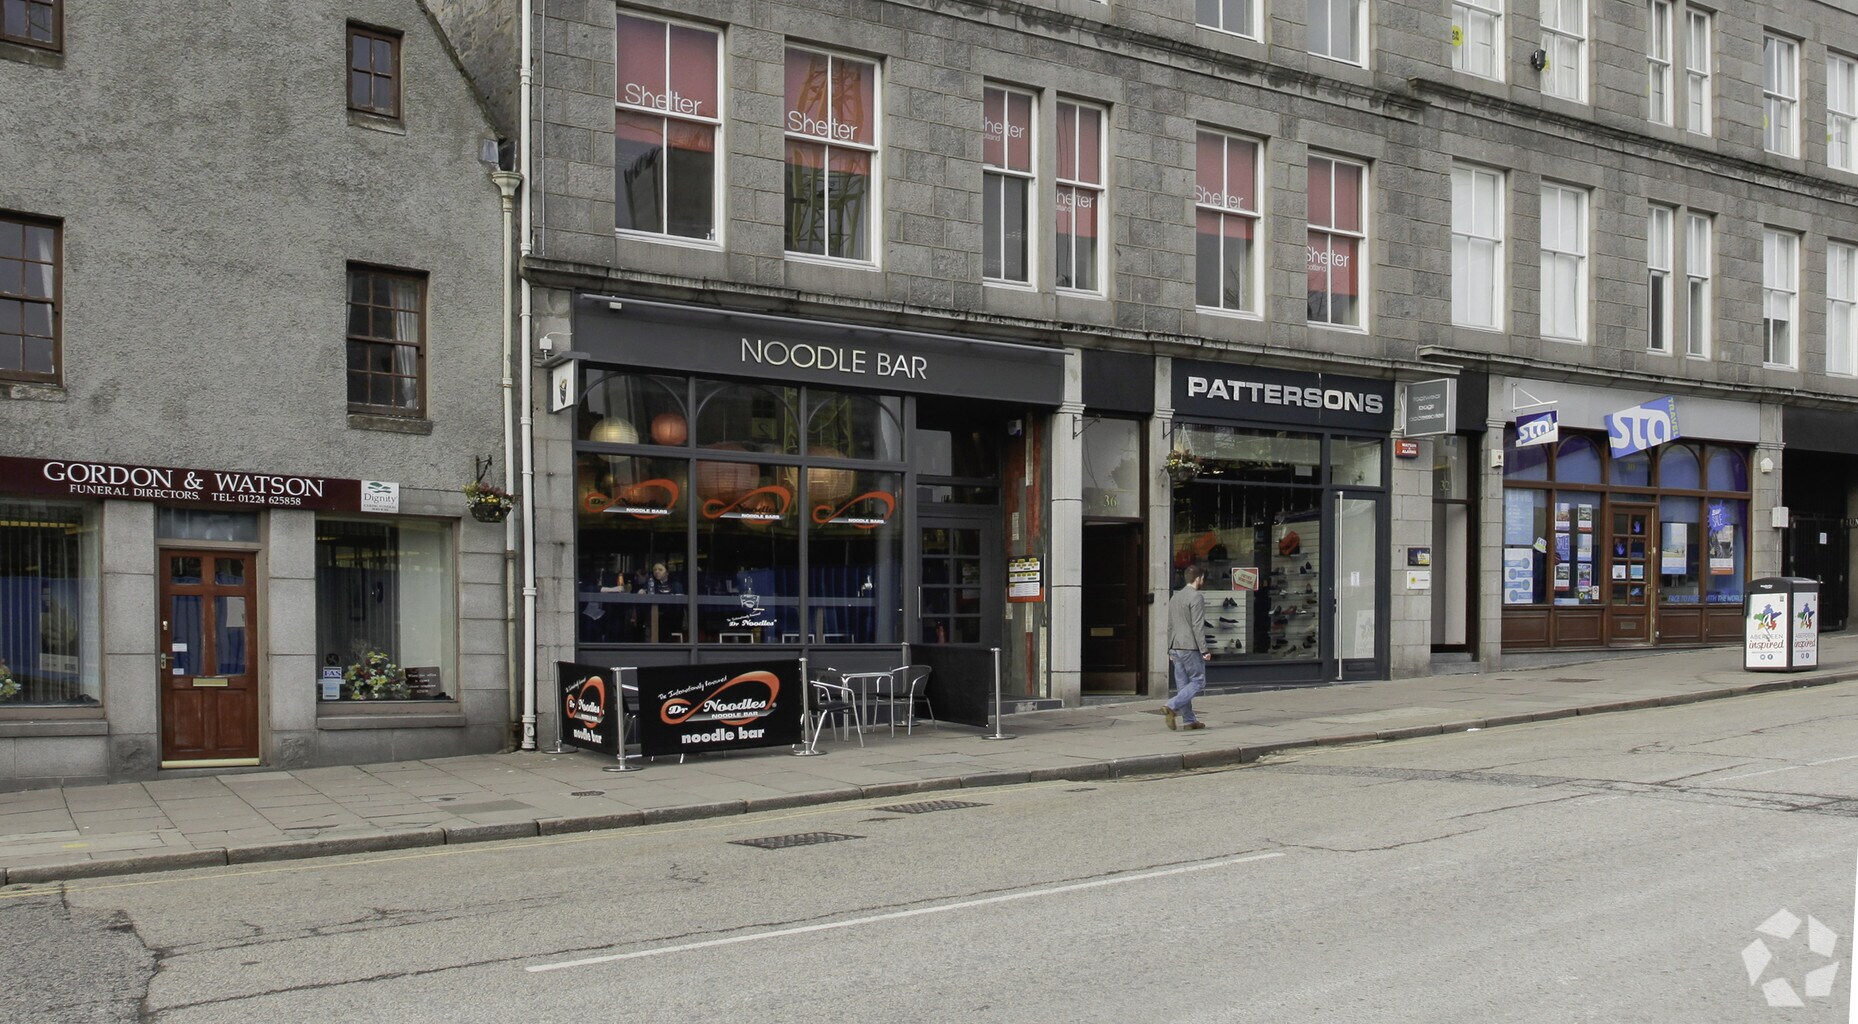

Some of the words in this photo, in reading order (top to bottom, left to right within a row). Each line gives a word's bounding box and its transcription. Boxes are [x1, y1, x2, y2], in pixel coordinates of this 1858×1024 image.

[625, 83, 702, 115] Shelter
[788, 110, 858, 140] Sheter
[1056, 188, 1094, 209] heter
[741, 338, 866, 374] NOODLE
[876, 352, 927, 380] BAR
[1187, 376, 1384, 414] PATTERSONS
[1667, 397, 1680, 437] TRAVEL
[43, 461, 173, 488] GORDON
[184, 471, 204, 490] &
[215, 473, 324, 497] WATSON
[70, 484, 130, 496] FUNERAL
[211, 492, 236, 502] TEL:
[238, 494, 265, 504] 01224
[268, 496, 302, 505] 625858
[364, 492, 397, 505] Dignity
[1103, 494, 1118, 507] 36
[1748, 639, 1784, 650] inspired
[1794, 639, 1815, 650] inspired
[668, 704, 688, 715] Dr
[703, 698, 767, 713] Noodles
[573, 727, 591, 742] noodle
[681, 728, 735, 744] noodle
[738, 727, 765, 740] bar
